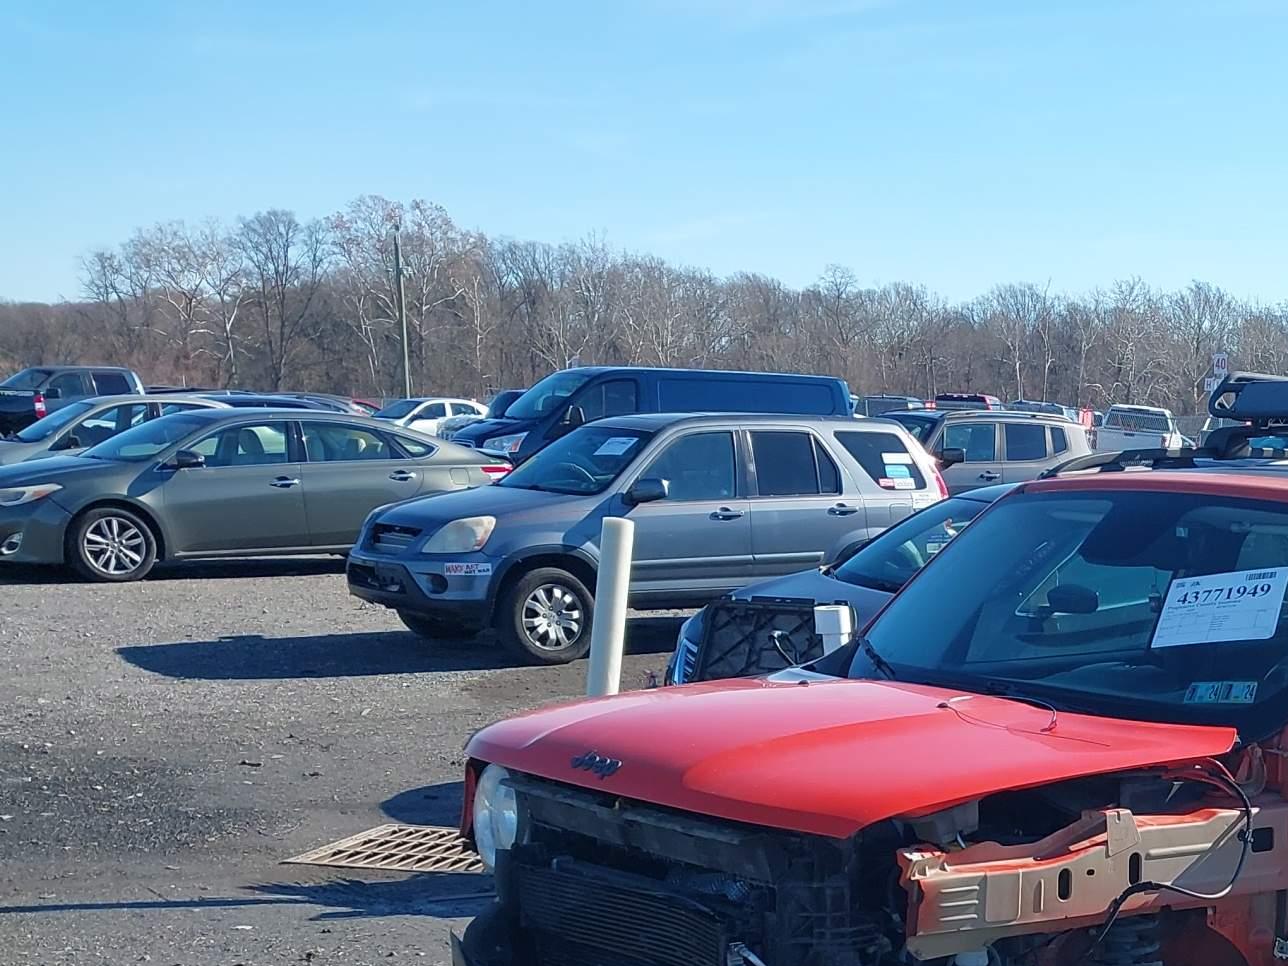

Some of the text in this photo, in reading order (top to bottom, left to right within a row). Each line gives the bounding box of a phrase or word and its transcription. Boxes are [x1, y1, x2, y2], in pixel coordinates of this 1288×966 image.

[1215, 357, 1227, 370] 40
[1176, 583, 1272, 605] 43771949
[571, 752, 622, 780] Jeep
